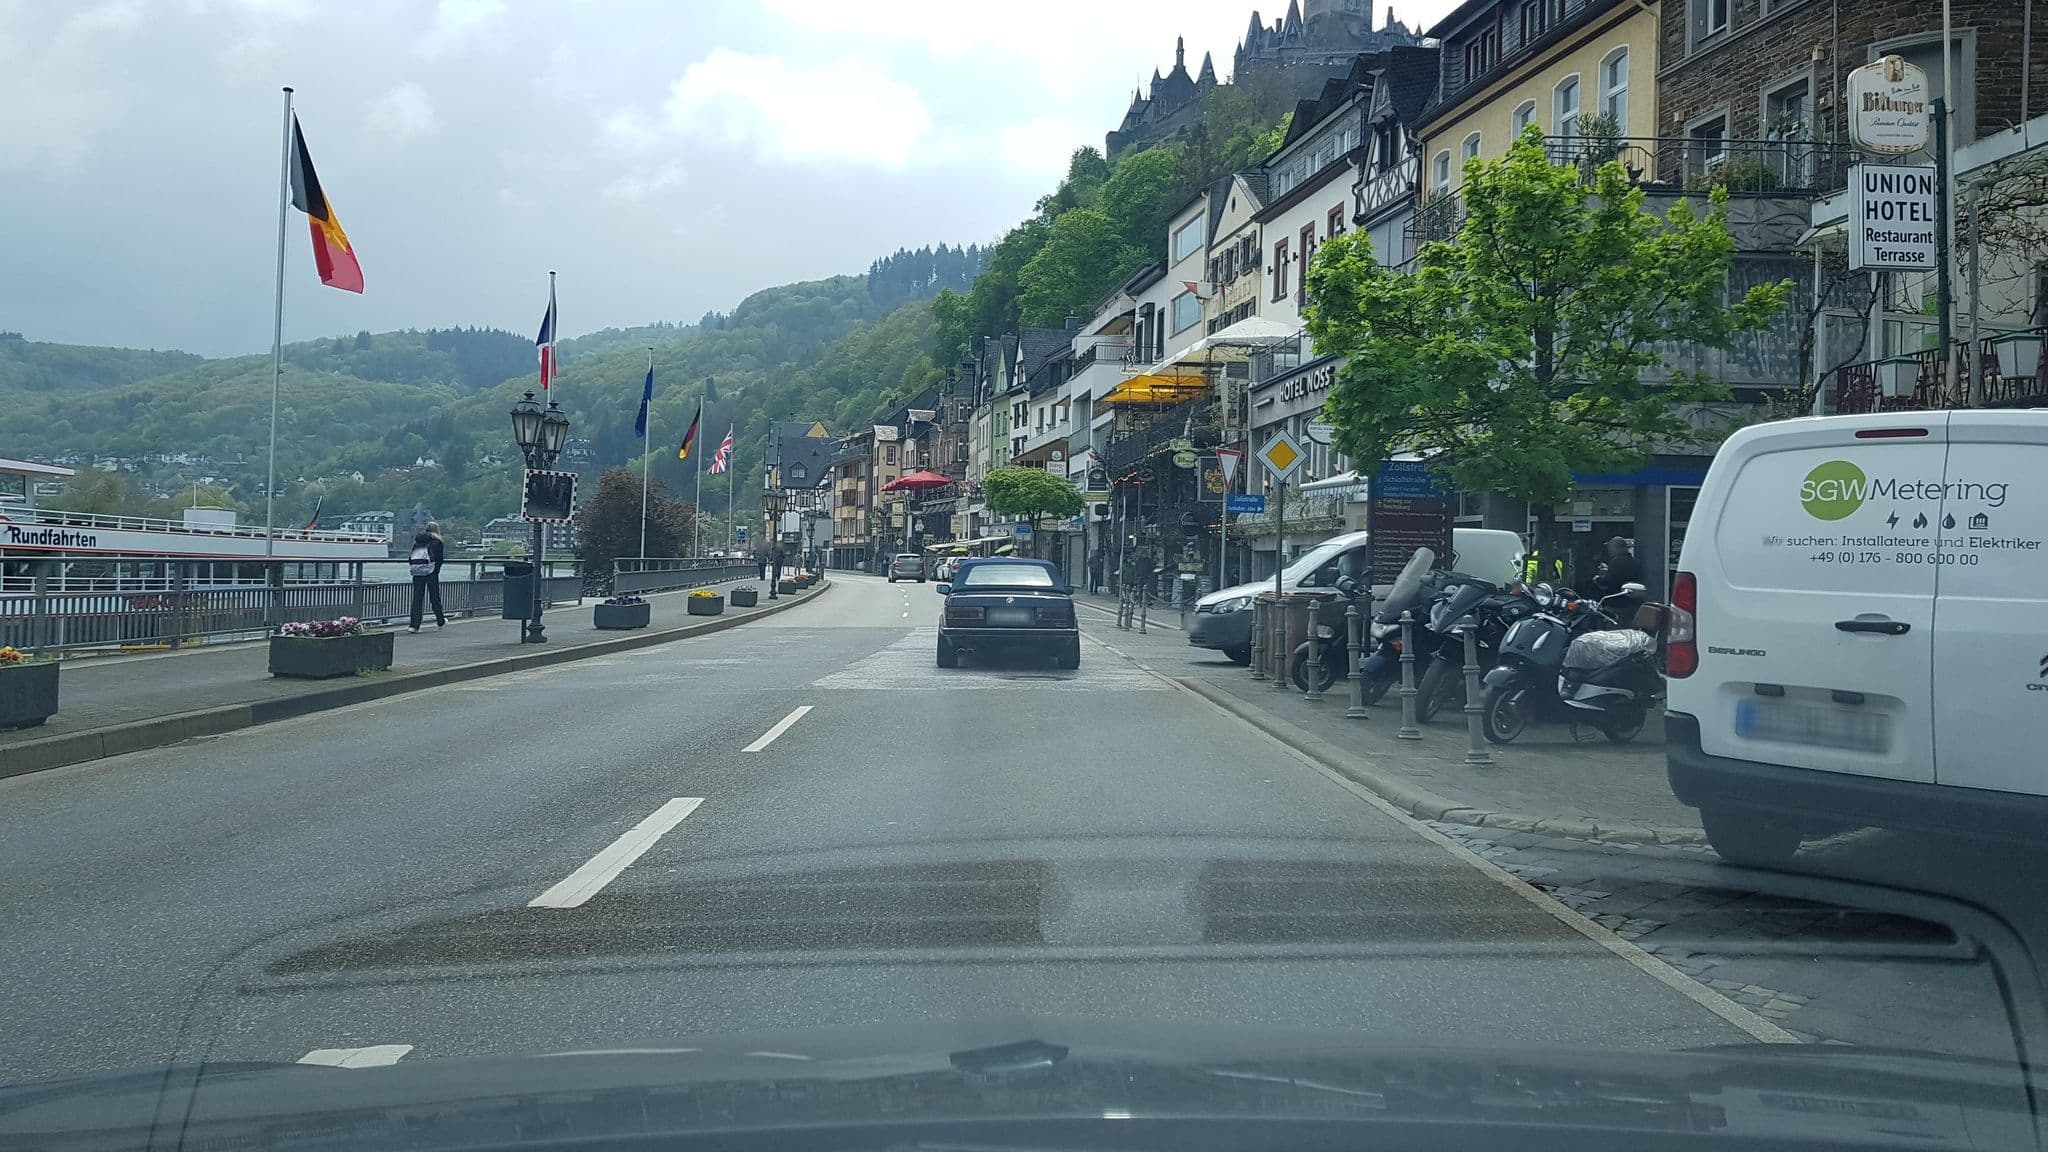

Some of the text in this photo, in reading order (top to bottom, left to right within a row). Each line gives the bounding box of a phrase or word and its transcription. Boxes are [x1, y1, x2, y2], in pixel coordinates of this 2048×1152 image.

[1862, 91, 1925, 115] Bitburger
[1865, 173, 1932, 195] UNION
[1866, 200, 1933, 222] HOTEL
[1865, 227, 1934, 244] Restaurant
[1873, 247, 1925, 262] Terrasse
[1279, 365, 1331, 402] HOTEL NOSS
[1799, 478, 2009, 507] SGW Metering
[11, 526, 96, 547] Rundfahrten
[1786, 536, 1837, 547] suchen:
[1841, 535, 1930, 548] Installateure
[1934, 536, 1964, 548] und
[1969, 537, 2042, 550] Elektriker
[1809, 551, 1834, 563] +49
[1838, 551, 1855, 565] (0)
[1859, 552, 1881, 564] 176
[1895, 552, 1923, 564] 800
[1926, 553, 1955, 565] 600
[1959, 553, 1979, 566] 00
